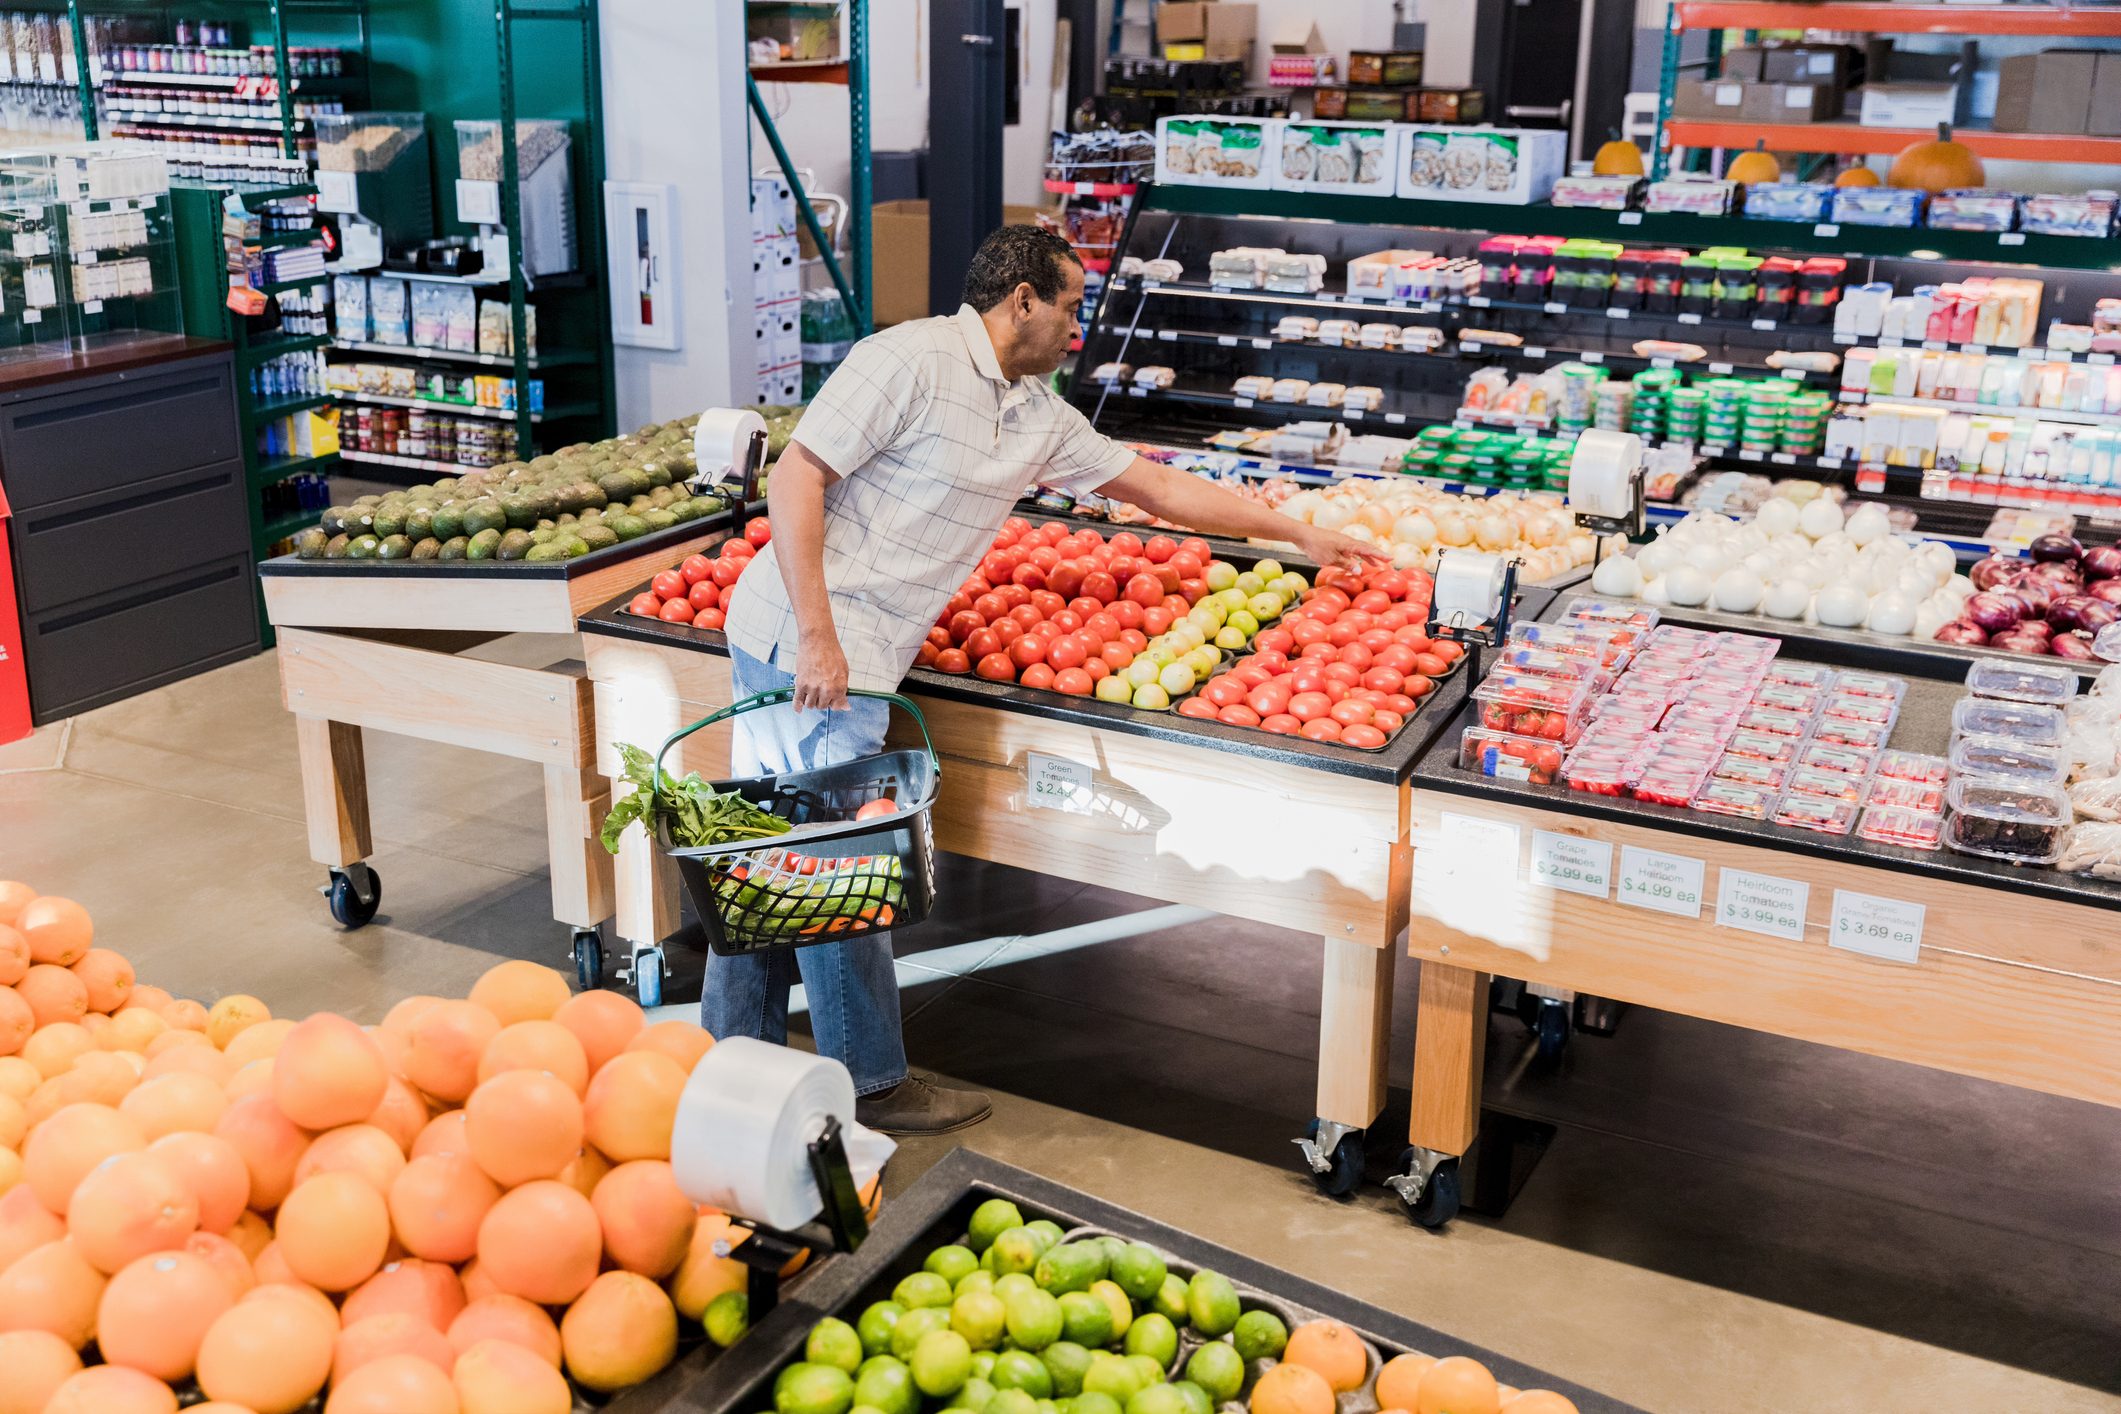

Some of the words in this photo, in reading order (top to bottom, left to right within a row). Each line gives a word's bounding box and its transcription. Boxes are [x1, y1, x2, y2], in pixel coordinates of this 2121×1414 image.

[1047, 762, 1072, 773] Green
[1041, 770, 1080, 785] Tomatoes
[1036, 781, 1043, 793] $
[1557, 841, 1587, 855] Grape
[1547, 850, 1596, 868] Tomatoes
[1647, 857, 1677, 871] Large
[1537, 861, 1546, 873] $
[1550, 864, 1581, 880] 2.99
[1585, 873, 1603, 885] ea
[1639, 867, 1684, 883] Heirloom
[1624, 877, 1633, 891] $
[1637, 882, 1672, 898] 4.99
[1677, 891, 1696, 903] ea
[1737, 877, 1793, 896] Heirloom
[1733, 890, 1795, 911] Tomatoes
[1862, 901, 1898, 914] Organic
[1727, 903, 1736, 917] $
[1741, 907, 1774, 923] 3.99
[1778, 916, 1797, 928] ea
[1839, 918, 1849, 931] $
[1854, 921, 1889, 939] 3.69
[1894, 931, 1913, 943] ea
